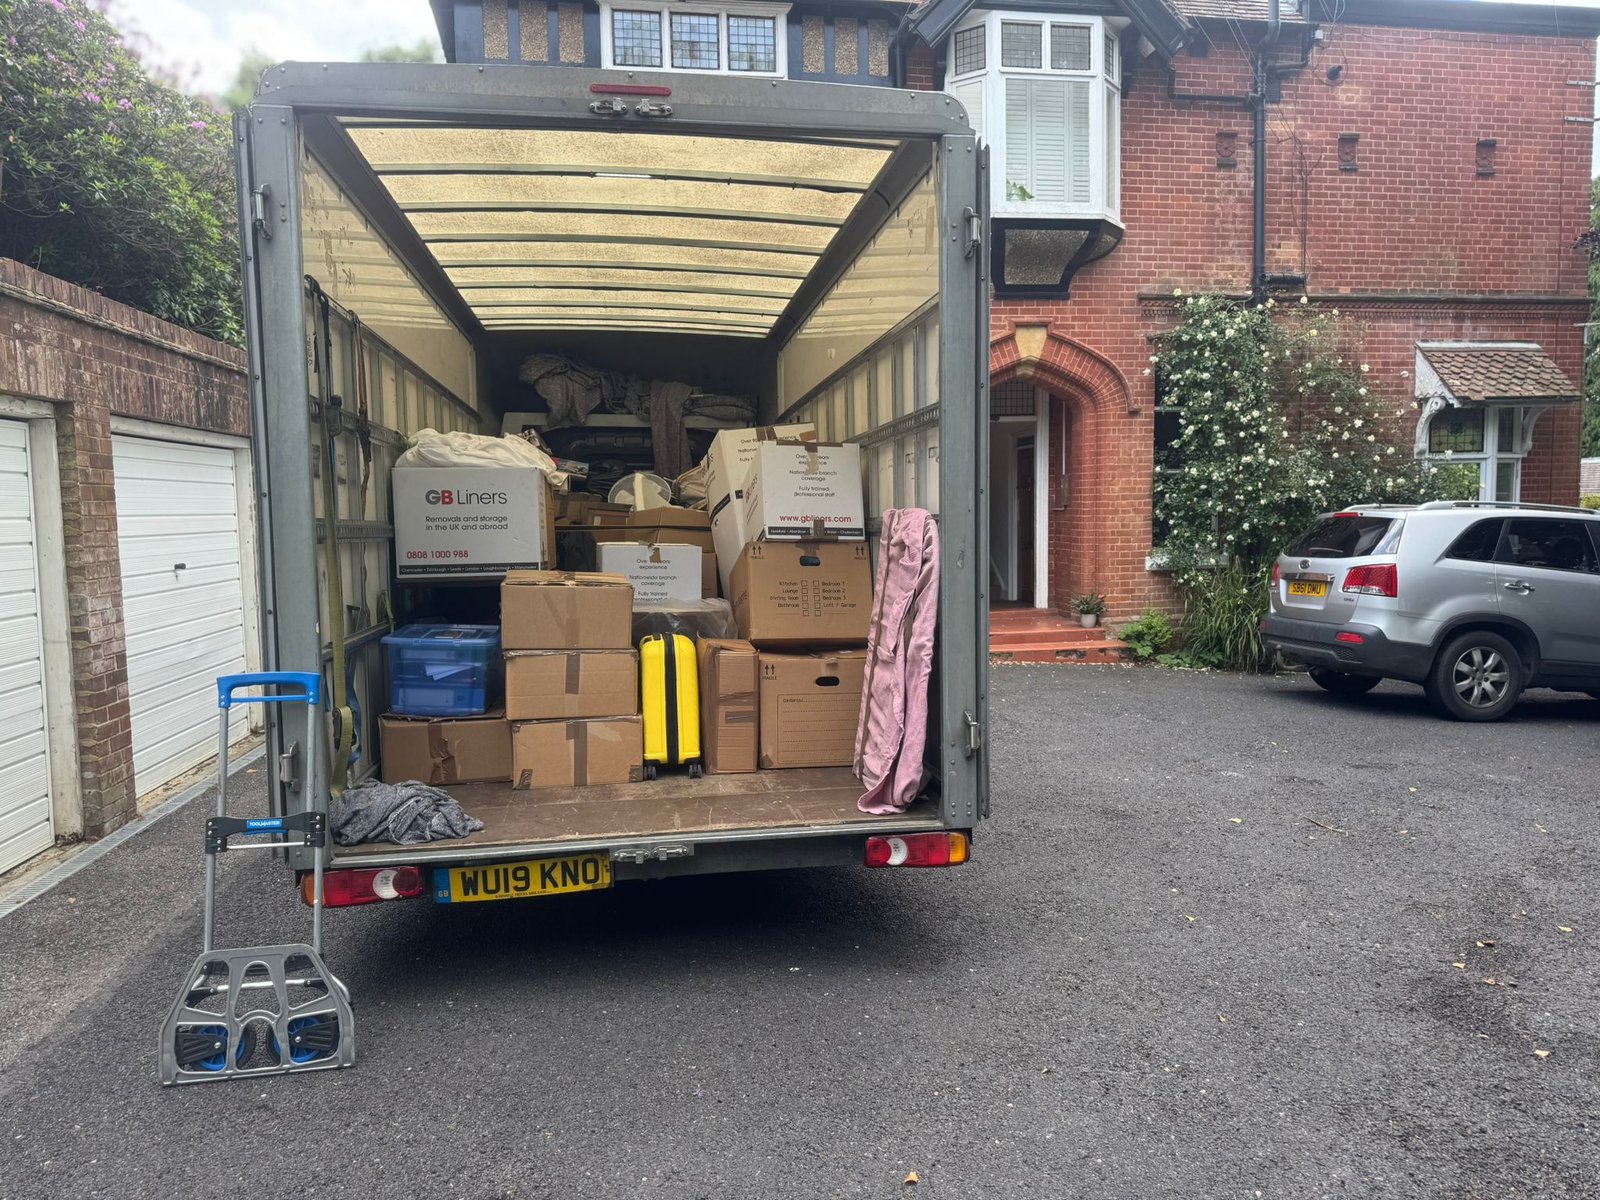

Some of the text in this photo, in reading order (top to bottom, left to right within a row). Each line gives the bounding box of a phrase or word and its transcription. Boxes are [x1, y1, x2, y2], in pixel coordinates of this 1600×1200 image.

[425, 489, 508, 505] GB Liners
[480, 514, 508, 524] storage
[406, 550, 469, 560] 0808 1000 988
[460, 858, 600, 896] WU19 KNO
